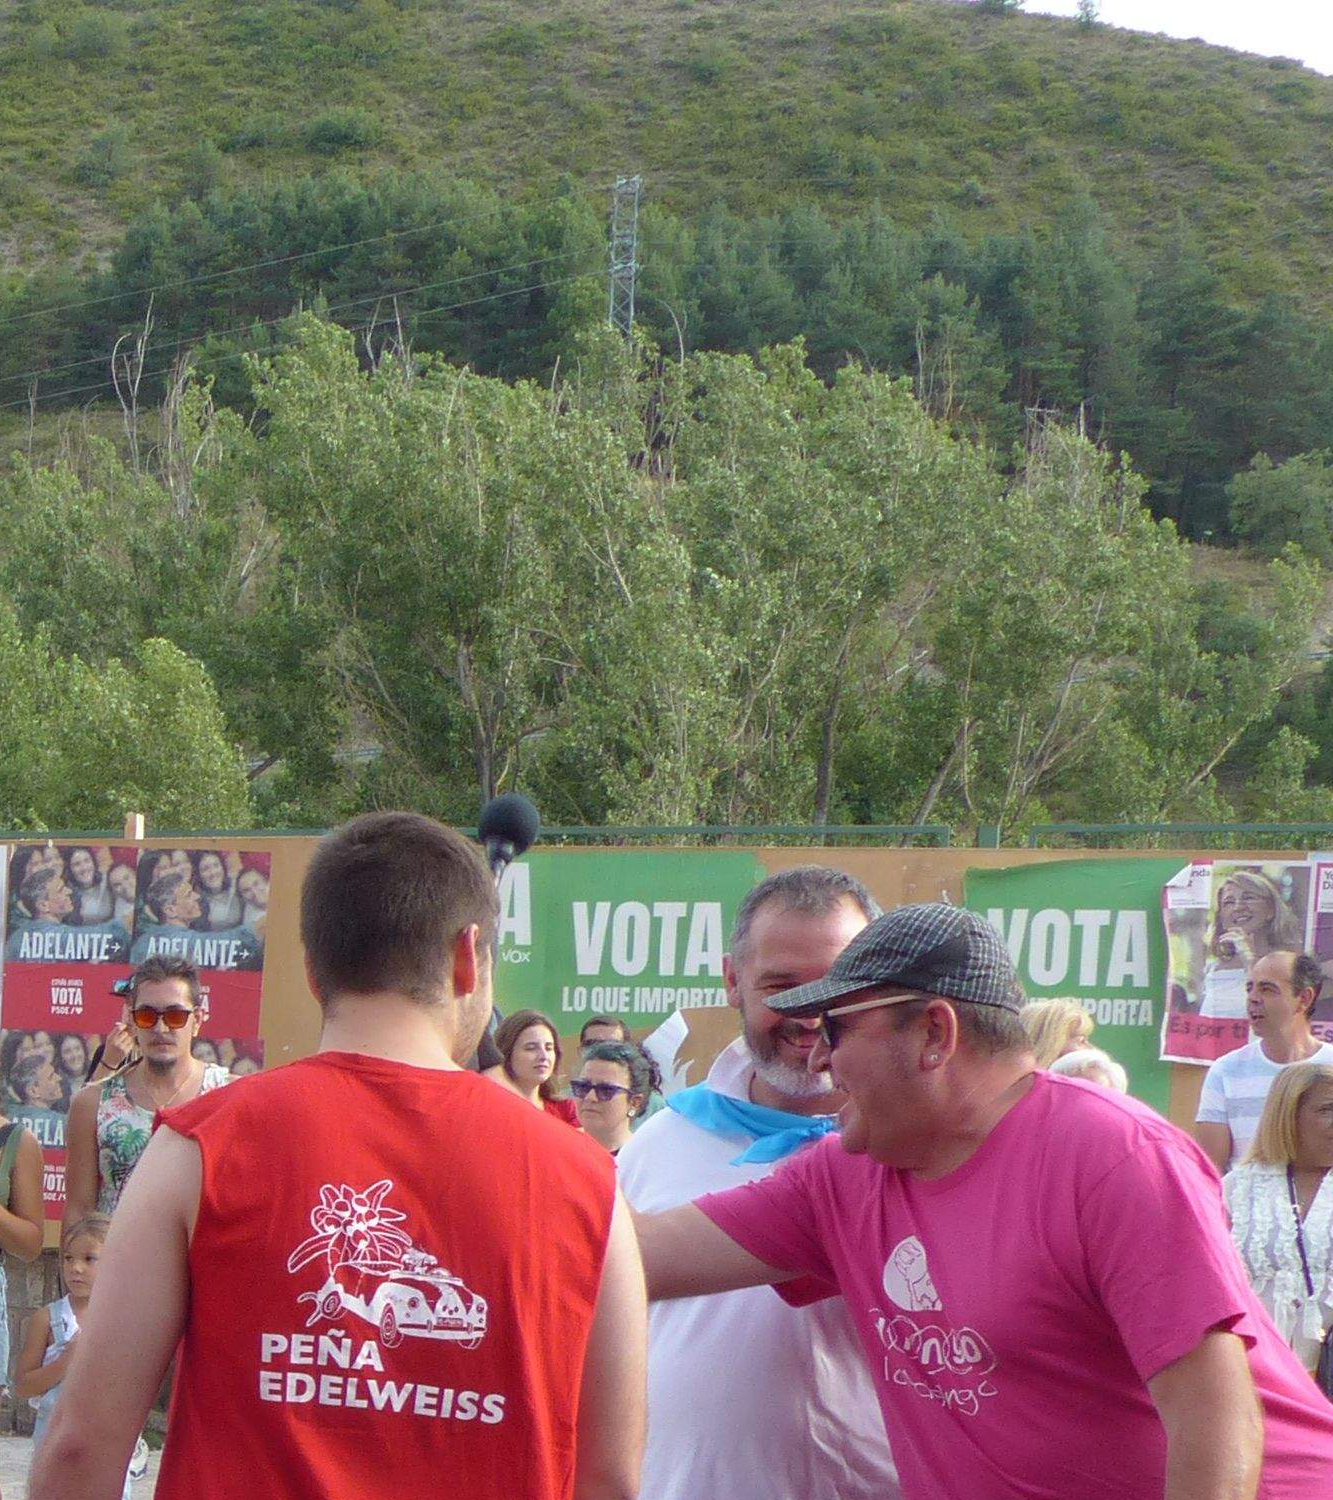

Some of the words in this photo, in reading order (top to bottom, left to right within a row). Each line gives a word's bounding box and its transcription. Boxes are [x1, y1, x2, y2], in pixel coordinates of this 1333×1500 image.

[19, 932, 113, 960] ADELANTE
[572, 901, 725, 976] VOTA
[987, 908, 1150, 988] VOTA
[501, 950, 531, 963] VOX
[51, 988, 83, 1005] VOTA
[562, 986, 588, 1012] LO
[591, 987, 630, 1013] QUE
[1080, 998, 1153, 1026] PORTA
[1196, 1023, 1225, 1040] por
[261, 1328, 384, 1371] PEÑA
[259, 1370, 506, 1424] EDELWEISS
